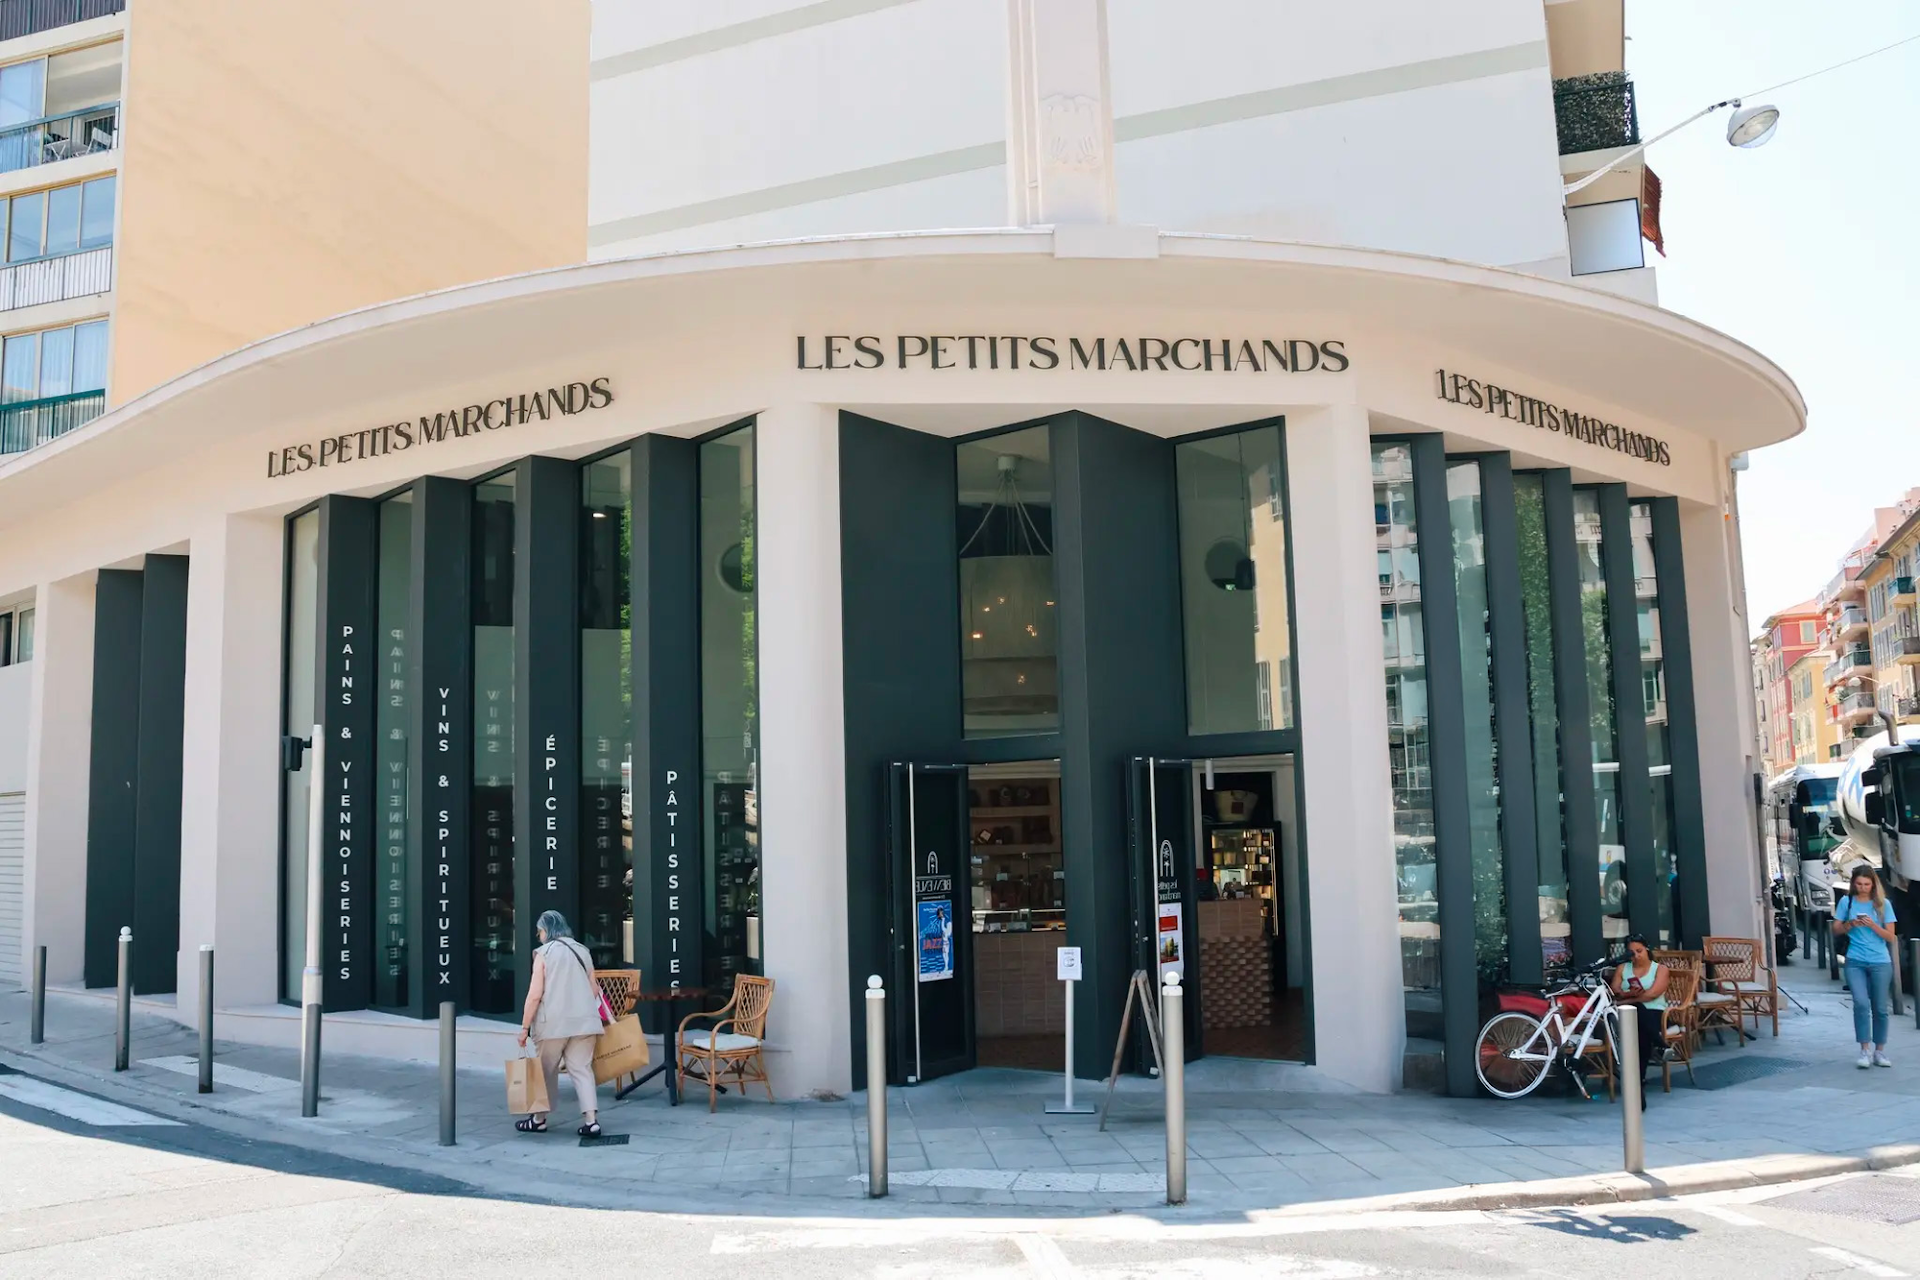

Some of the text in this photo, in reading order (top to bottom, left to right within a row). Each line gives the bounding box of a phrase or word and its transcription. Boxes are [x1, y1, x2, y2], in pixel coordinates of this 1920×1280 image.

[797, 335, 1350, 373] LES PETITS MARCHANDS
[1435, 368, 1672, 467] LES PETITS MARCHANDS
[266, 376, 615, 478] LES PETITS MARCHANDS
[339, 625, 354, 980] PAINS & VIENNOISERIES
[438, 687, 451, 985] VINS & SPIRITUEUX
[545, 733, 558, 891] ÉPICERIE
